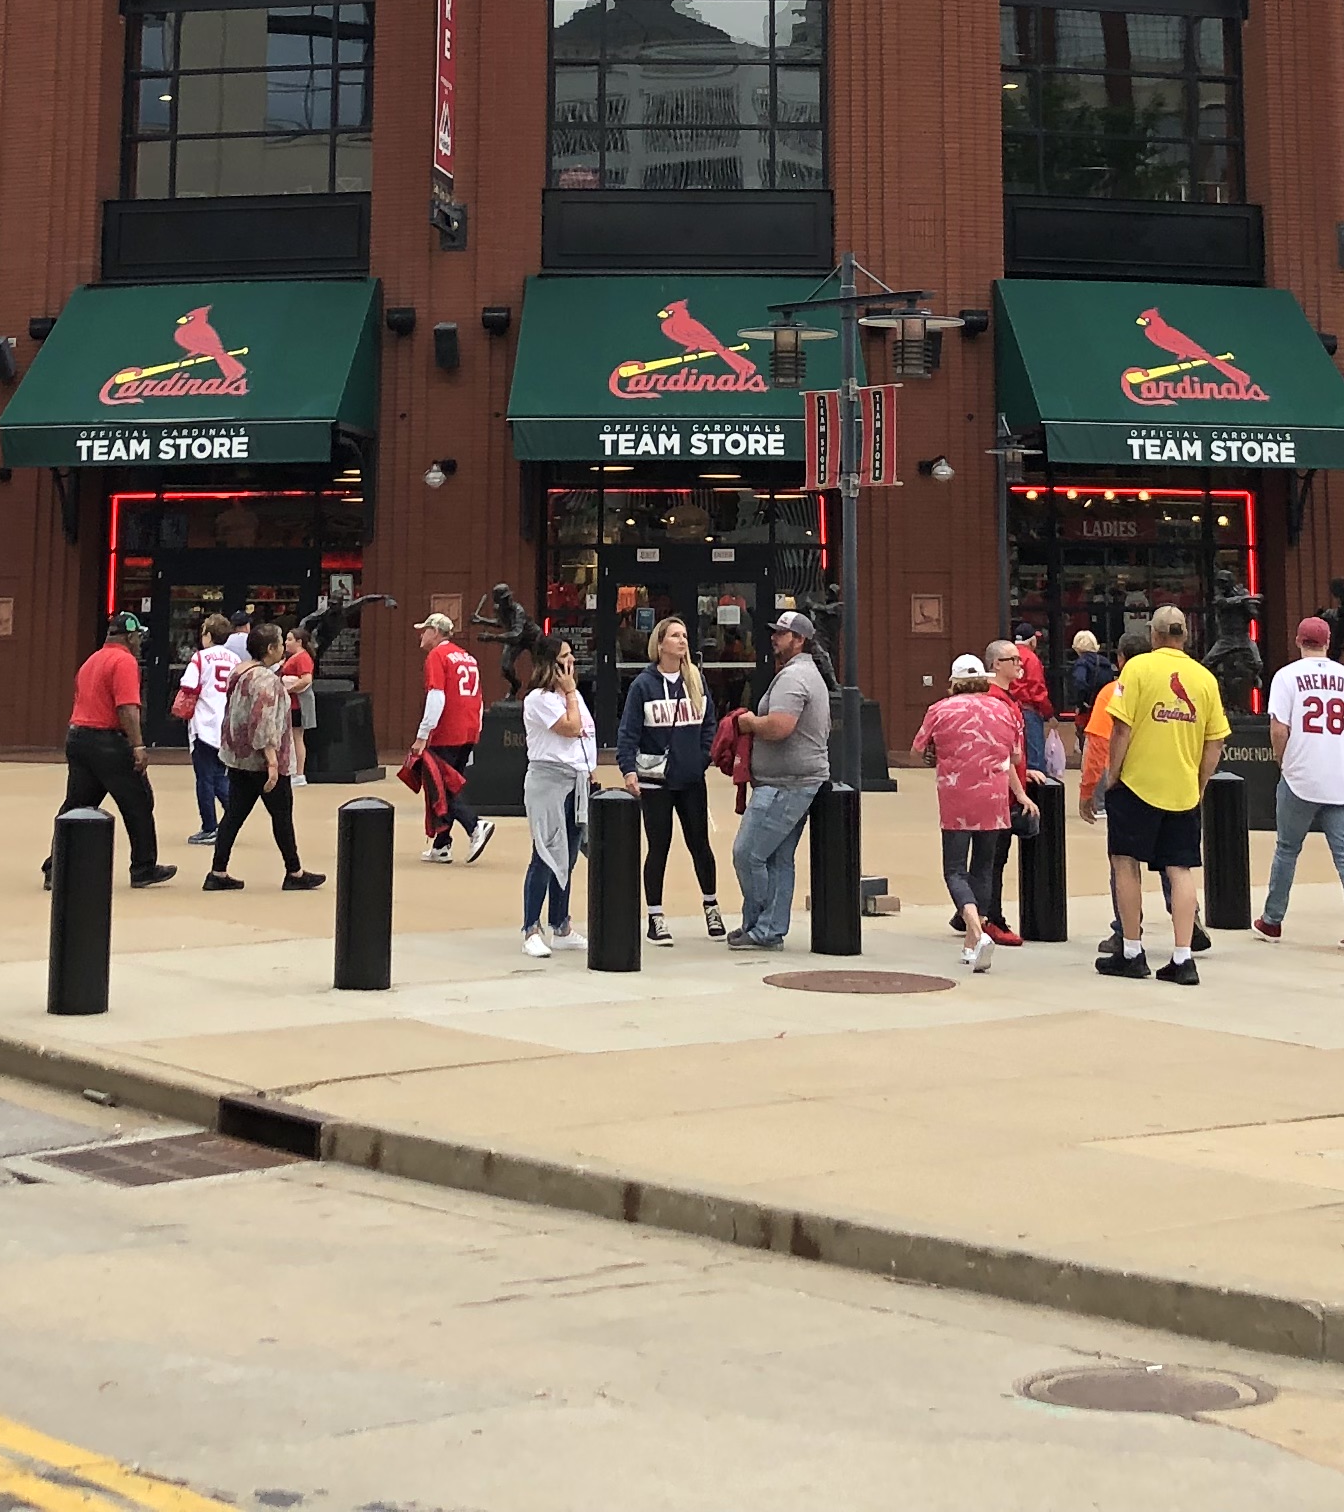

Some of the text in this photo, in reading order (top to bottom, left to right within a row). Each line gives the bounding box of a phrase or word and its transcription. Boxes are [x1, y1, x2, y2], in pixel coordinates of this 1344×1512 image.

[99, 366, 250, 405] Cardinals
[608, 360, 769, 399] Cardinals
[1121, 366, 1270, 406] Cardinals
[80, 427, 246, 439] OFFICIAL CARDINALS
[603, 424, 782, 433] OFFICIAL CARDINALS
[1130, 429, 1291, 441] OFFICIAL CARDINALS
[76, 437, 249, 462] TEAM STORE
[599, 433, 785, 456] TEAM STORE
[1127, 438, 1296, 464] TEAM STORE
[1082, 520, 1138, 538] LADIES
[214, 665, 231, 693] 5
[456, 665, 480, 697] 27
[1222, 744, 1277, 762] SCHOENDIE
